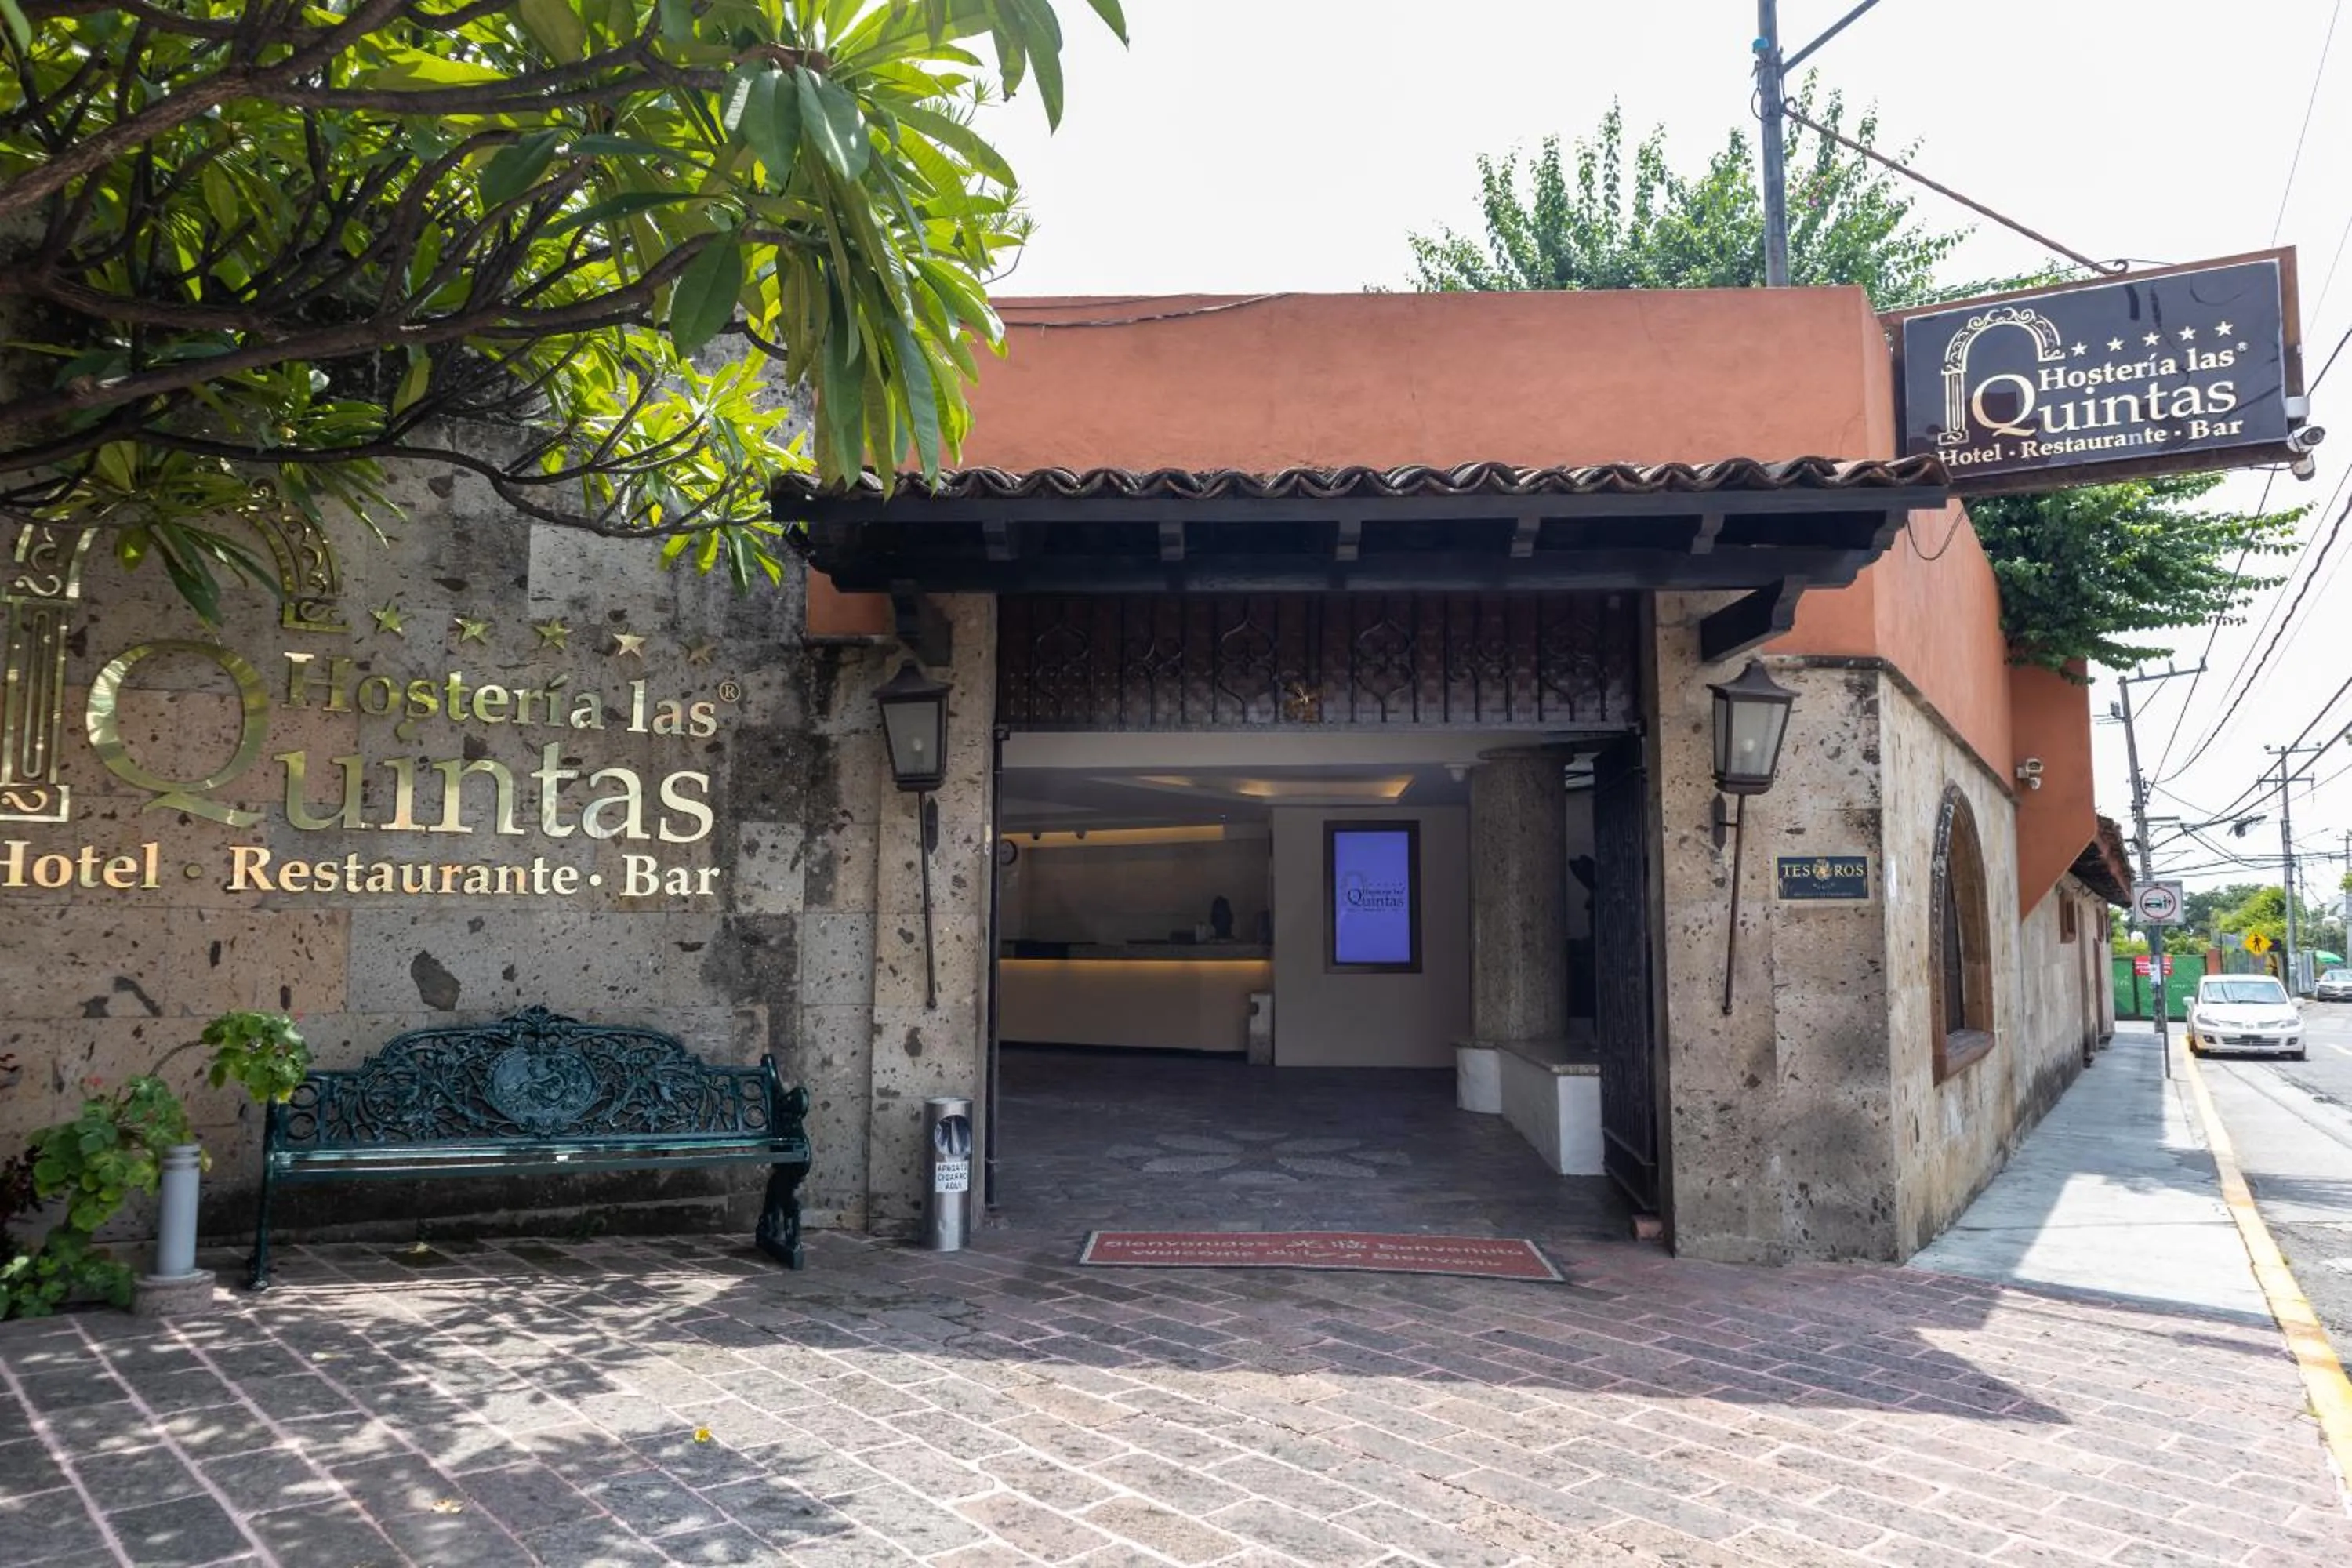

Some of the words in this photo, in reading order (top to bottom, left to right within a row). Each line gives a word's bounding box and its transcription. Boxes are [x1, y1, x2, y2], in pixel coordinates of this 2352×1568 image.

[2038, 353, 2178, 391] Hostería
[1971, 374, 2237, 437] Quintas
[1938, 443, 2002, 466] Hotel
[2020, 428, 2167, 459] Restaurante
[2188, 419, 2244, 440] Bar
[281, 652, 605, 730] Hostería
[85, 639, 715, 844] Quintas
[227, 846, 579, 895] Restaurante
[619, 854, 720, 897] Bar
